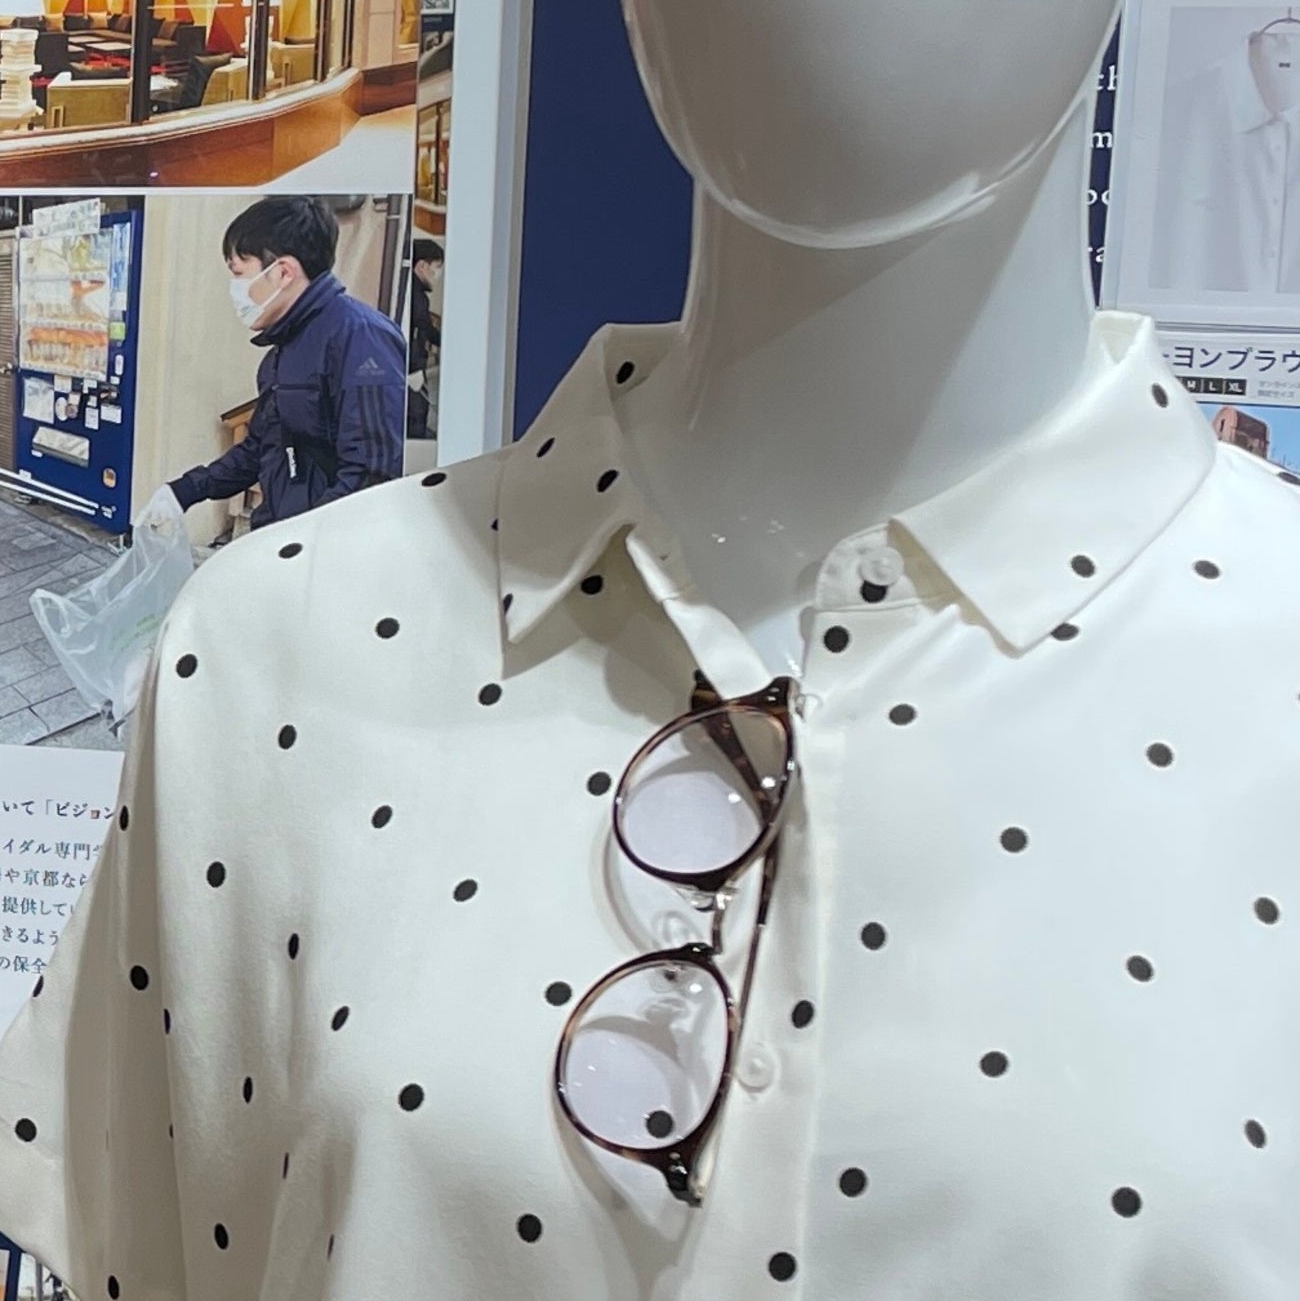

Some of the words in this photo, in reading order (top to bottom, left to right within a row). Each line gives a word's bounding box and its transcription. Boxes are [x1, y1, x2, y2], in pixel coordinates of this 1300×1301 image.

[1163, 345, 1300, 373] ヨンブラウ
